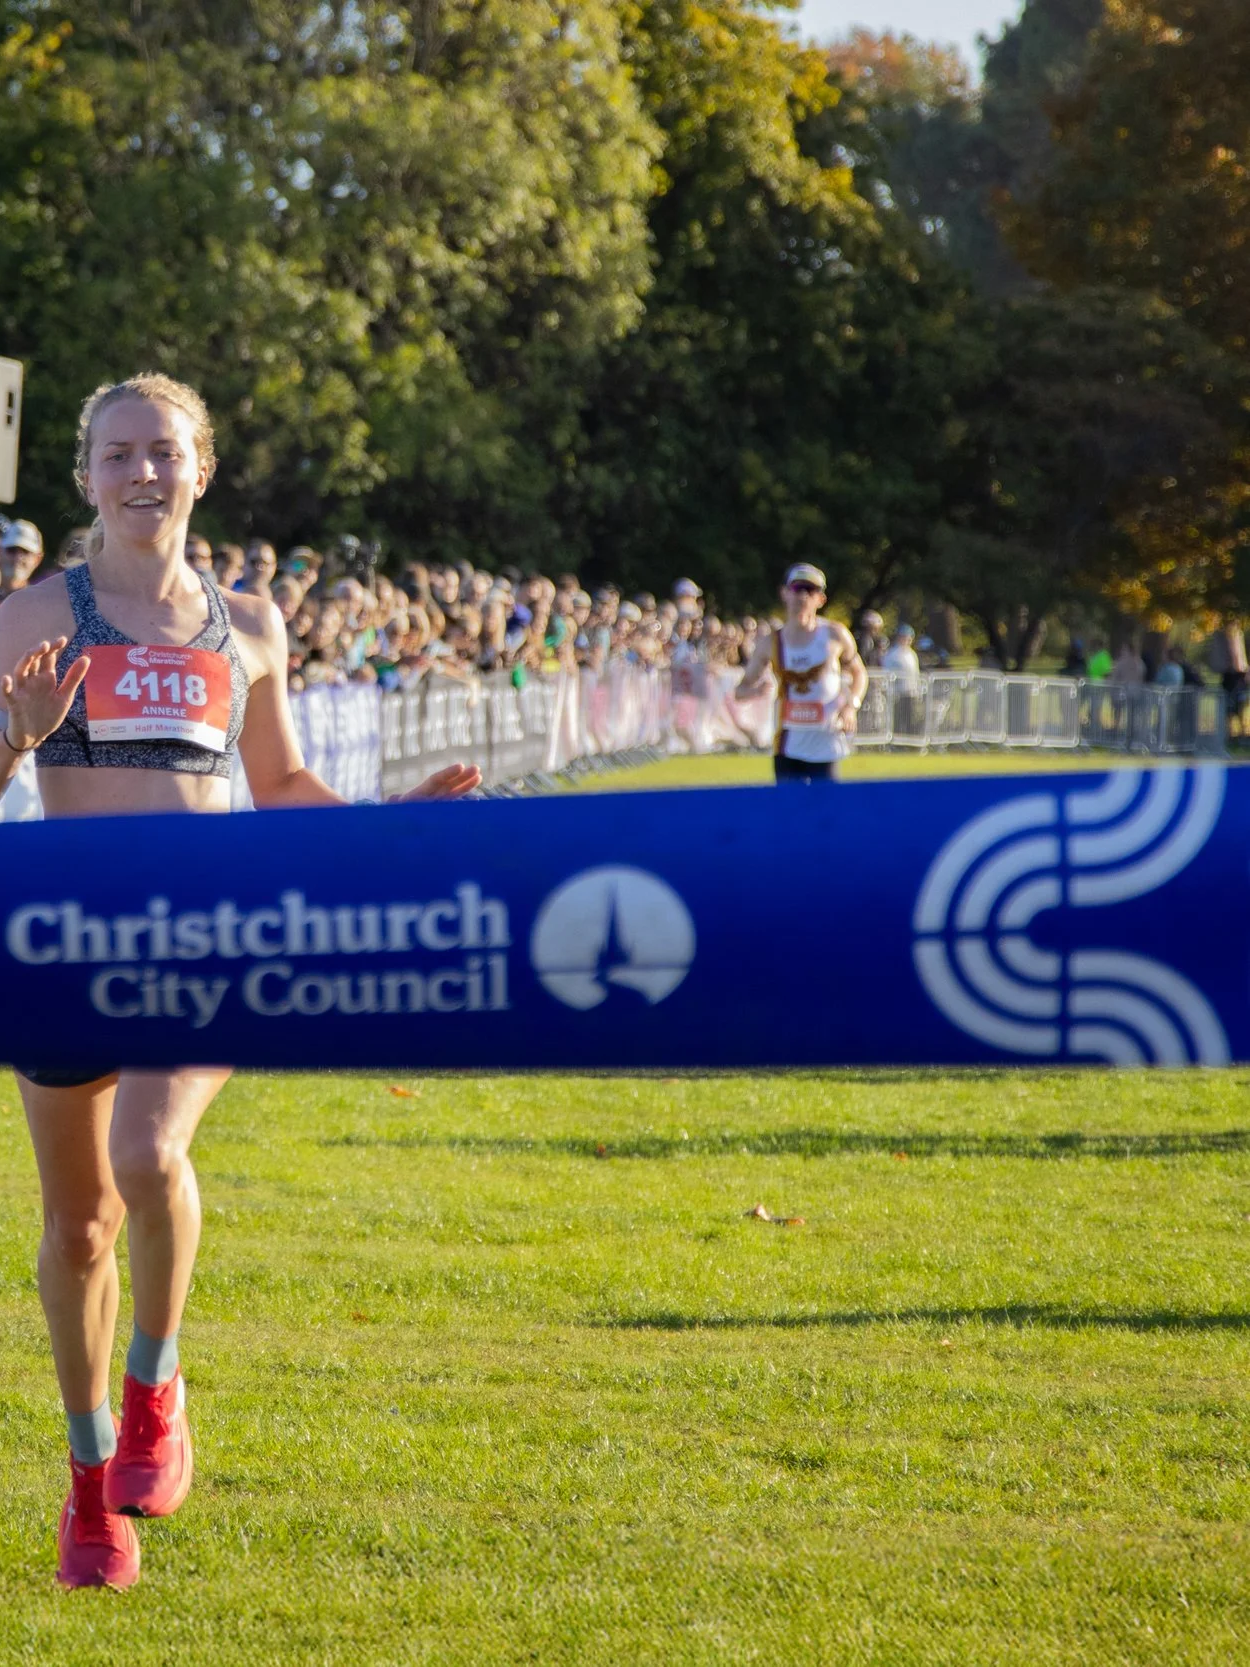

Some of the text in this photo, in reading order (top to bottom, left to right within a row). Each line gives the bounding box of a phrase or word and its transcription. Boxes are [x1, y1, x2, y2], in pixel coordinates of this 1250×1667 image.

[149, 650, 193, 660] Christchurch
[149, 657, 186, 666] Marathon
[115, 670, 208, 707] 4118
[142, 706, 187, 717] ANNEKE
[135, 724, 152, 733] Half
[155, 724, 195, 735] Marathon
[6, 881, 511, 965] Christchurch
[90, 954, 510, 1029] City Council
